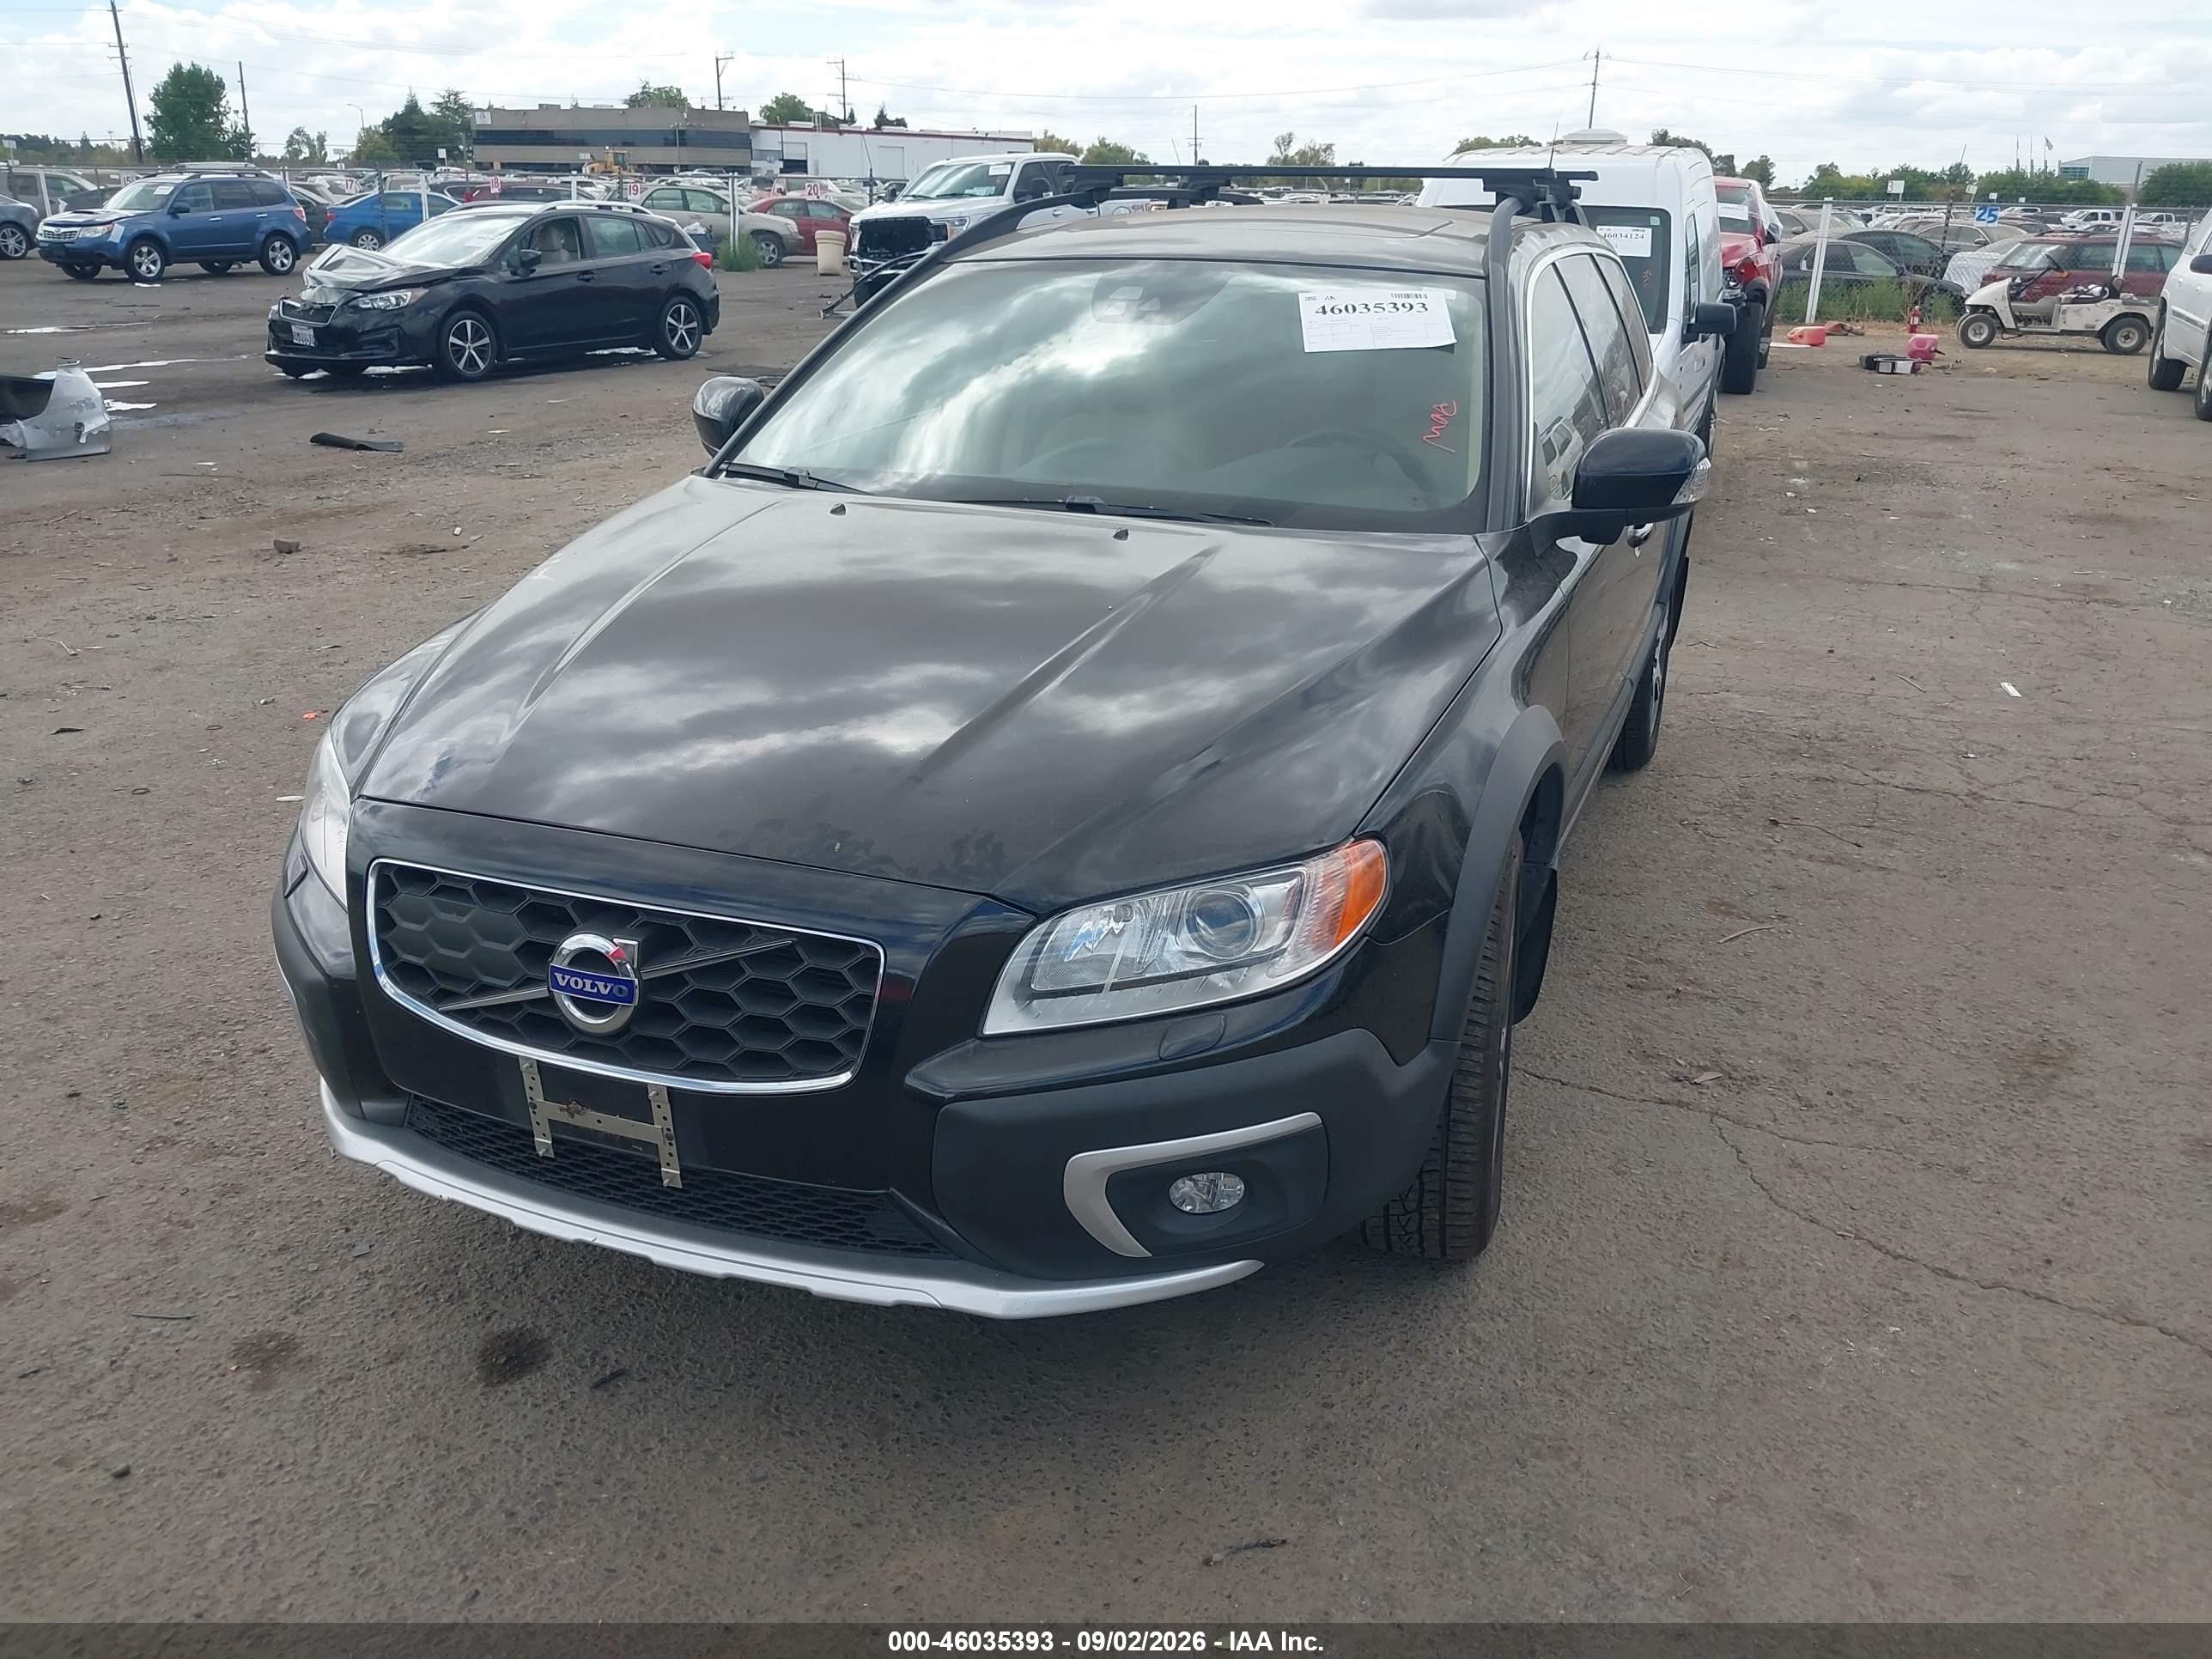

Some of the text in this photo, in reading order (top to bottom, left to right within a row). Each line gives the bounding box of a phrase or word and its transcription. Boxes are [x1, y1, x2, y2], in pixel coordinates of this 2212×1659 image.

[345, 179, 354, 191] 17
[490, 178, 500, 191] 18
[629, 185, 639, 196] 19
[807, 184, 819, 197] 20
[1975, 206, 1999, 223] 25
[1315, 301, 1429, 316] 46035393
[553, 972, 629, 998] VOLVO
